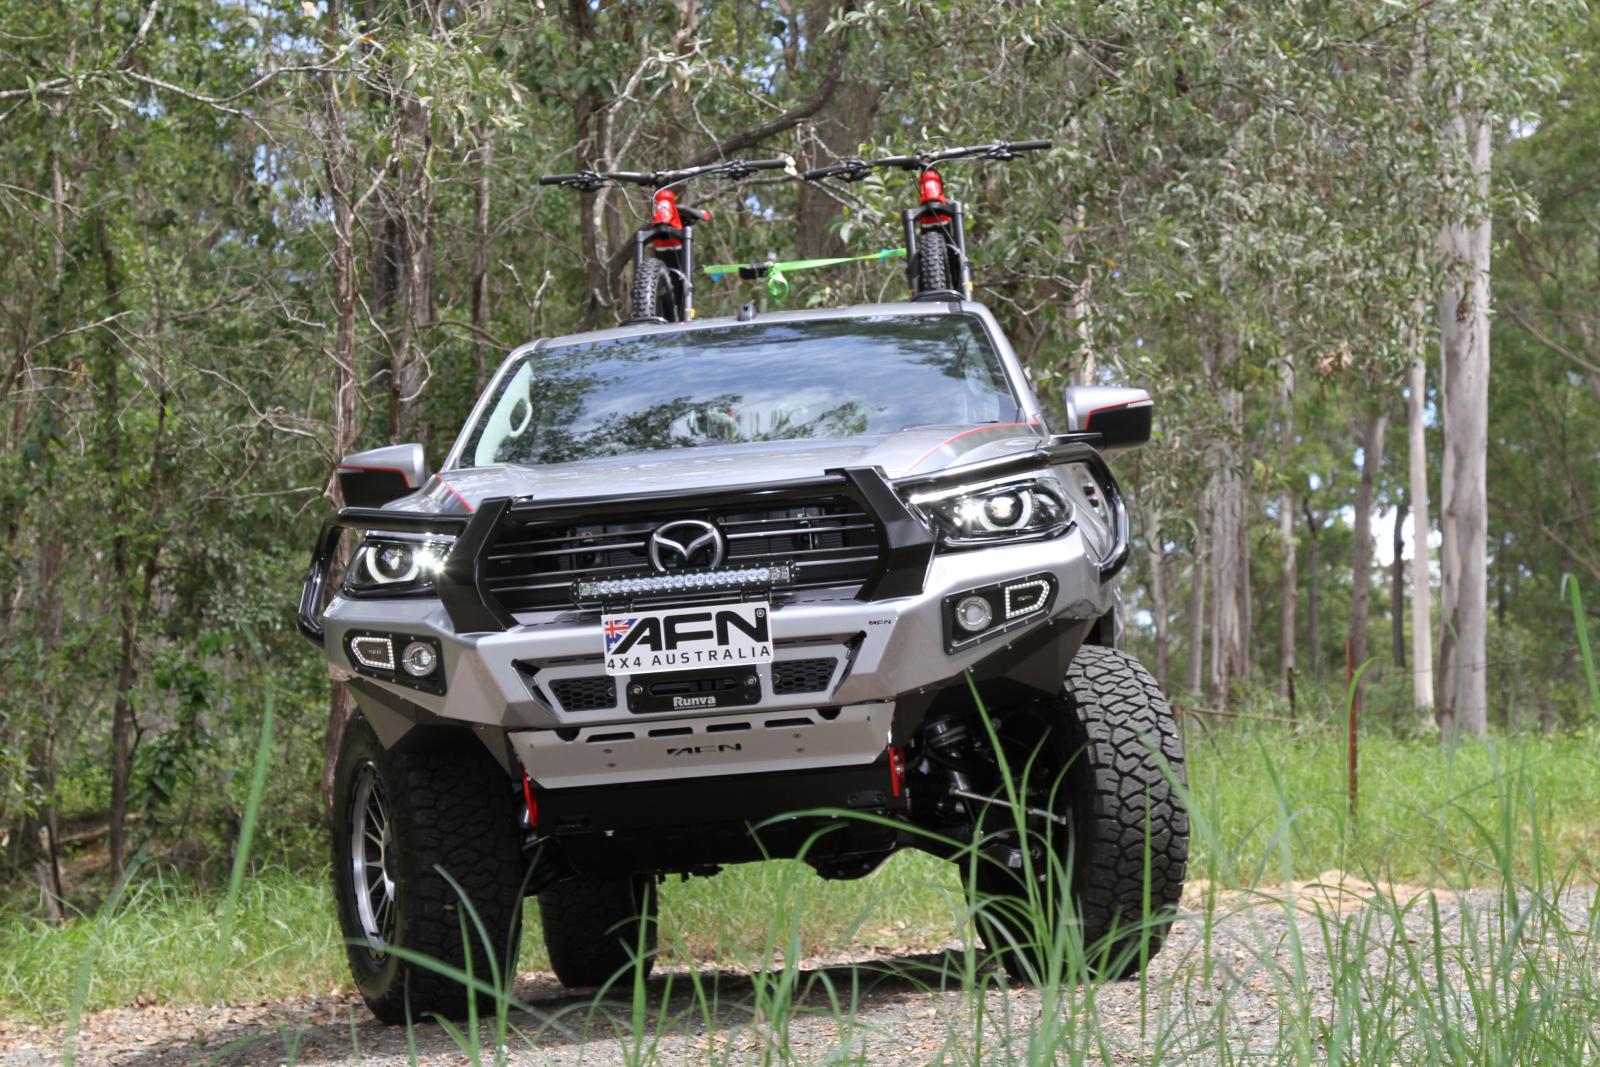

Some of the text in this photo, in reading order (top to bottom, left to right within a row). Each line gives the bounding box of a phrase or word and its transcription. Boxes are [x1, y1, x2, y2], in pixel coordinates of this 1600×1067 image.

[611, 607, 769, 656] AFN
[607, 645, 770, 670] 4X4 AUSTRALIA
[673, 695, 716, 707] Runva
